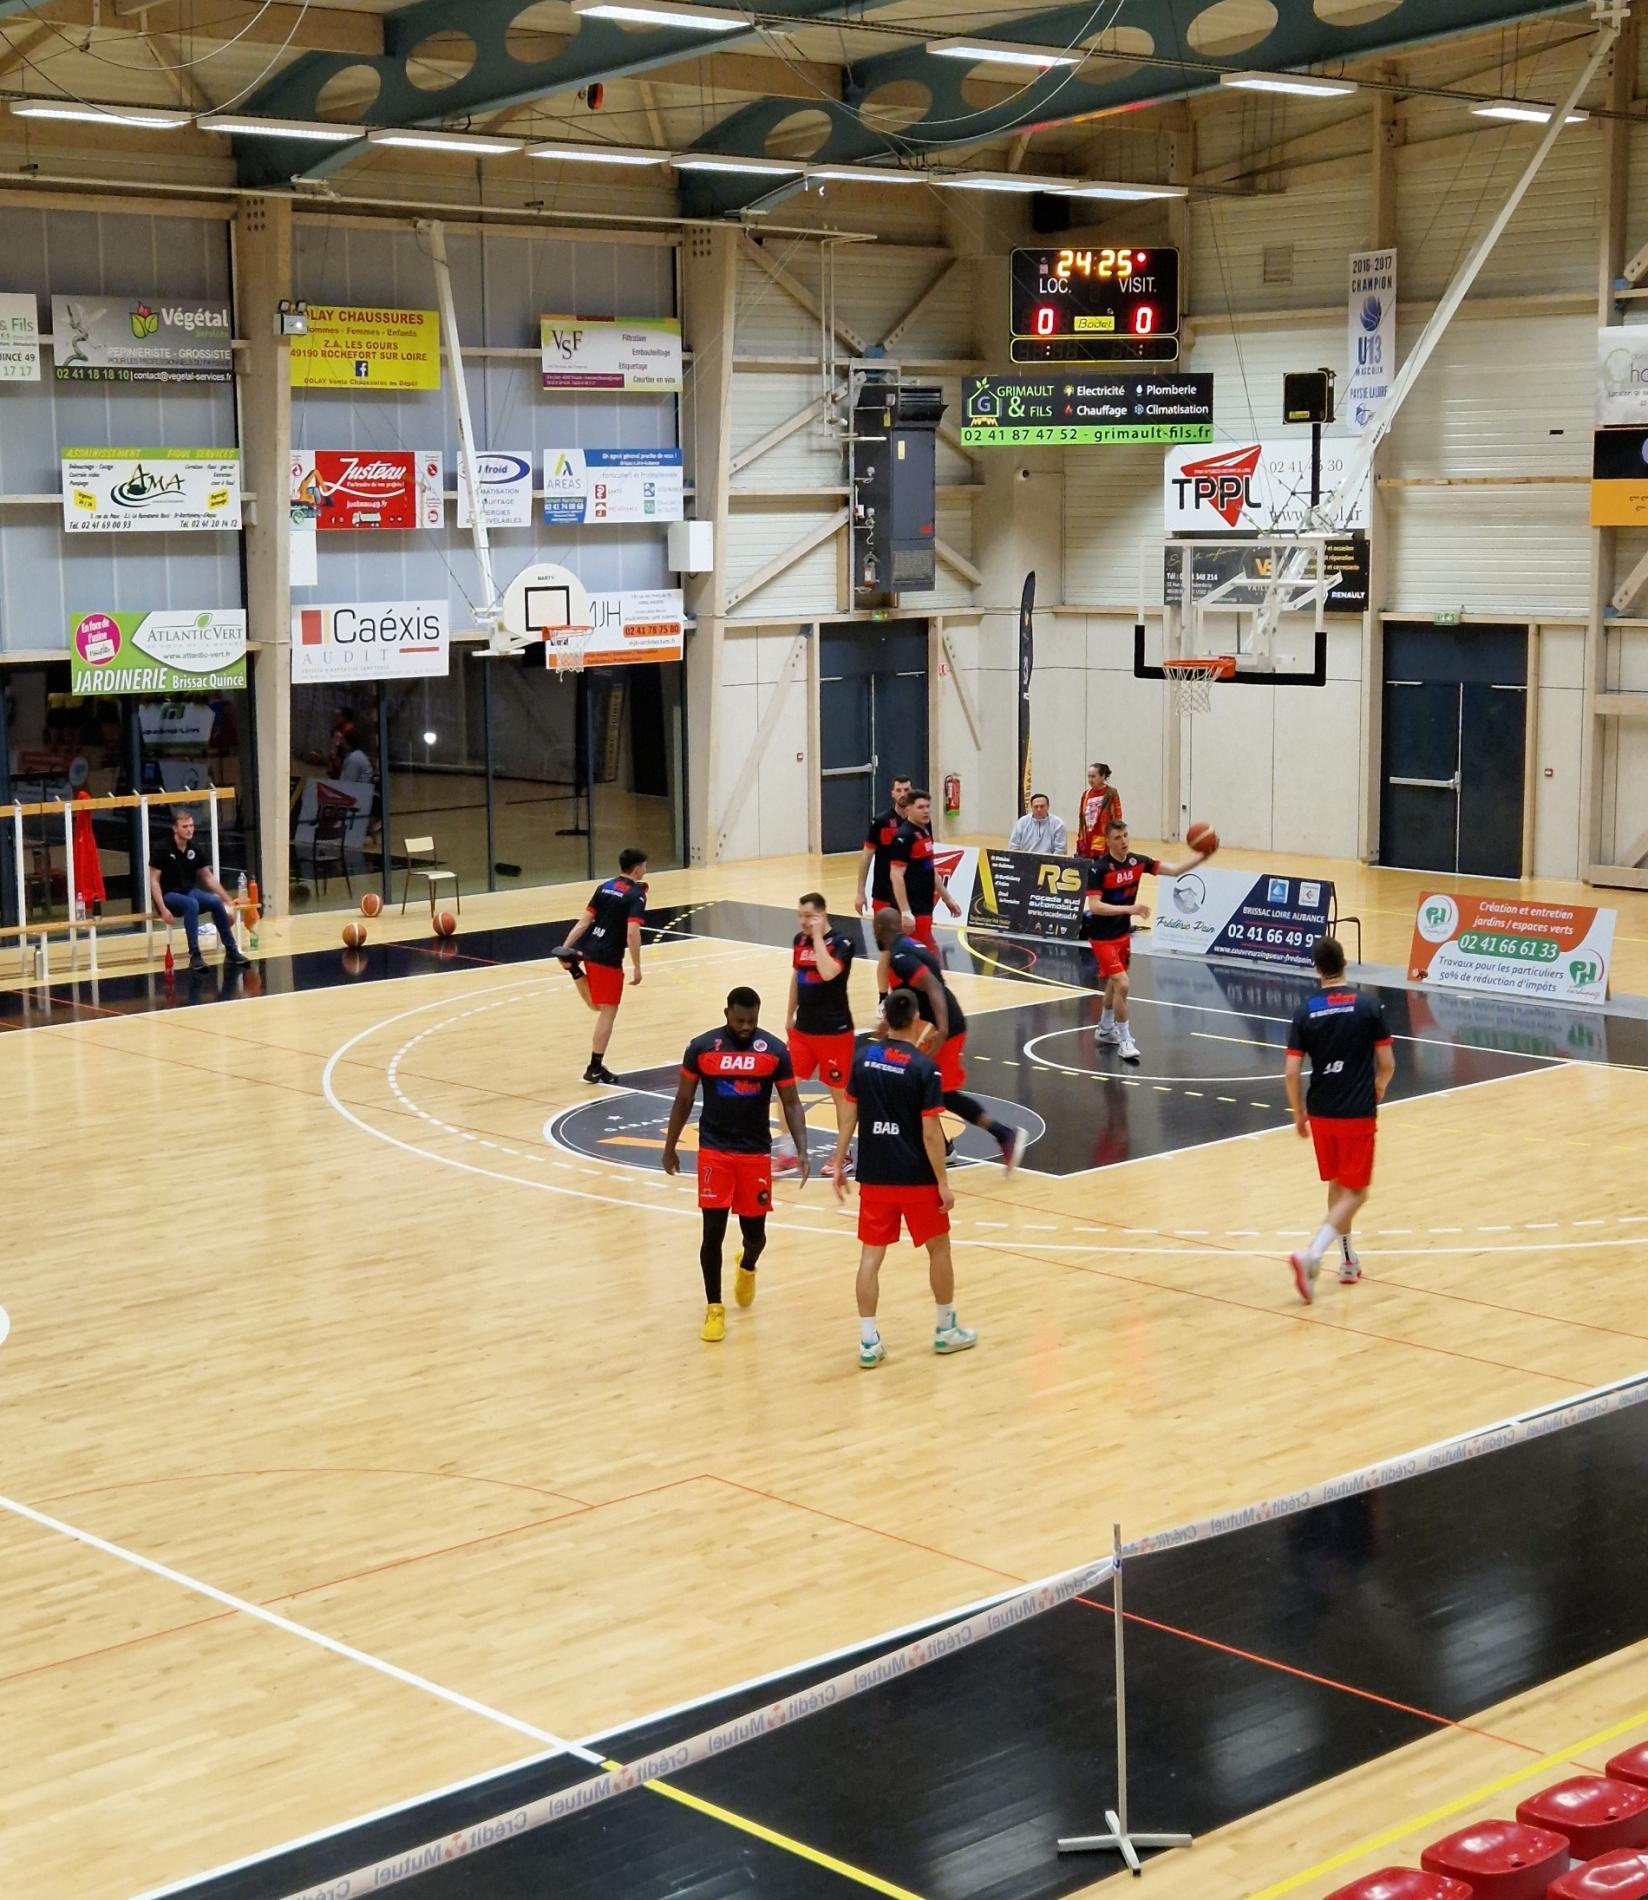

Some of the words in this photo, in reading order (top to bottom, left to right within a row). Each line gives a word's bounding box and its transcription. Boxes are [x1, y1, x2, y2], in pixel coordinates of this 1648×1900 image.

[1039, 278, 1072, 294] LOC.
[1118, 276, 1157, 293] VISIT.
[1352, 276, 1392, 293] CHAMPION
[12, 317, 34, 332] Fils
[160, 307, 228, 331] Végétal
[338, 310, 424, 324] CHAUSSURES
[1038, 308, 1054, 335] 0
[1135, 307, 1152, 334] 0
[346, 327, 380, 336] Femmes
[387, 328, 418, 337] Enfants
[324, 340, 342, 348] Z.A.
[345, 340, 362, 349] LES
[366, 341, 398, 350] GOURS
[1358, 335, 1382, 366] U13
[24, 353, 36, 362] 49
[178, 348, 232, 360] GROSSISTE
[290, 348, 318, 358] 49190
[321, 350, 376, 360] ROCHEFORT
[380, 351, 398, 360] SUR
[401, 352, 428, 361] LOIRE
[4, 366, 16, 376] 17
[20, 366, 32, 376] 17
[56, 368, 70, 380] 02
[72, 368, 84, 380] 41
[118, 370, 130, 380] 10
[633, 376, 655, 384] Courtier
[996, 386, 1054, 398] GRIMAULT
[1077, 384, 1126, 396] Electricité
[1146, 384, 1198, 396] Plomberie
[977, 396, 991, 412] G
[1008, 395, 1025, 417] &
[1030, 405, 1052, 416] FILS
[1076, 404, 1128, 417] Chauffage
[1146, 404, 1209, 414] Climatisation
[964, 430, 982, 441] 02
[988, 430, 1005, 440] 41
[1012, 429, 1030, 440] 87
[1036, 428, 1054, 440] 47
[1060, 428, 1077, 440] 52
[1094, 426, 1211, 442] grimault-fils.fr
[196, 448, 235, 458] SERVICES
[339, 457, 407, 483] Justeau
[486, 464, 508, 474] froid
[1269, 461, 1284, 474] 02
[1288, 461, 1303, 474] 41
[1327, 460, 1343, 472] 30
[128, 463, 185, 492] AMA
[1172, 476, 1262, 511] TPPL
[81, 521, 90, 530] 02
[102, 521, 111, 529] 69
[112, 521, 121, 529] 00
[123, 520, 132, 529] 93
[192, 520, 200, 528] 02
[81, 623, 90, 633] En
[90, 620, 102, 632] face
[102, 618, 110, 628] de
[334, 606, 440, 644] Caéxis
[625, 626, 634, 636] 02
[637, 626, 646, 635] 41
[659, 624, 668, 634] 75
[302, 648, 389, 666] AUDIT
[74, 668, 168, 693] JARDINERIE
[172, 675, 207, 689] Brissac
[210, 672, 244, 688] Quincé
[1037, 864, 1082, 895] RS
[1116, 870, 1134, 884] BAB
[1028, 901, 1080, 912] automobile
[1030, 894, 1062, 904] rocade
[1064, 897, 1081, 906] sud
[1028, 909, 1078, 920] www.rocadesud.fr
[1242, 906, 1271, 917] BRISSAC
[1272, 909, 1291, 919] LOIRE
[1292, 912, 1325, 924] AUBANCE
[1480, 902, 1518, 915] Création
[1519, 907, 1530, 915] et
[1530, 908, 1573, 920] entretien
[1156, 916, 1191, 930] Frédéric
[1472, 916, 1506, 929] jardins
[1512, 921, 1548, 933] espaces
[1550, 925, 1574, 936] verts
[1228, 924, 1244, 939] 02
[1247, 926, 1263, 942] 41
[1266, 929, 1283, 944] 66
[1285, 931, 1302, 947] 49
[1460, 934, 1476, 950] 02
[1480, 936, 1496, 952] 41
[1499, 938, 1516, 954] 66
[1519, 940, 1536, 956] 61
[1539, 943, 1558, 959] 33
[1439, 956, 1474, 970] Travaux
[1475, 963, 1496, 976] pour
[1497, 962, 1510, 973] les
[1512, 965, 1564, 980] particuliers
[1440, 971, 1459, 982] 50%
[1461, 972, 1471, 982] de
[1473, 974, 1516, 987] réduction
[1517, 979, 1557, 993] d'impôts
[720, 1056, 756, 1070] BAB
[872, 1122, 900, 1135] BAB
[703, 1167, 712, 1183] 7
